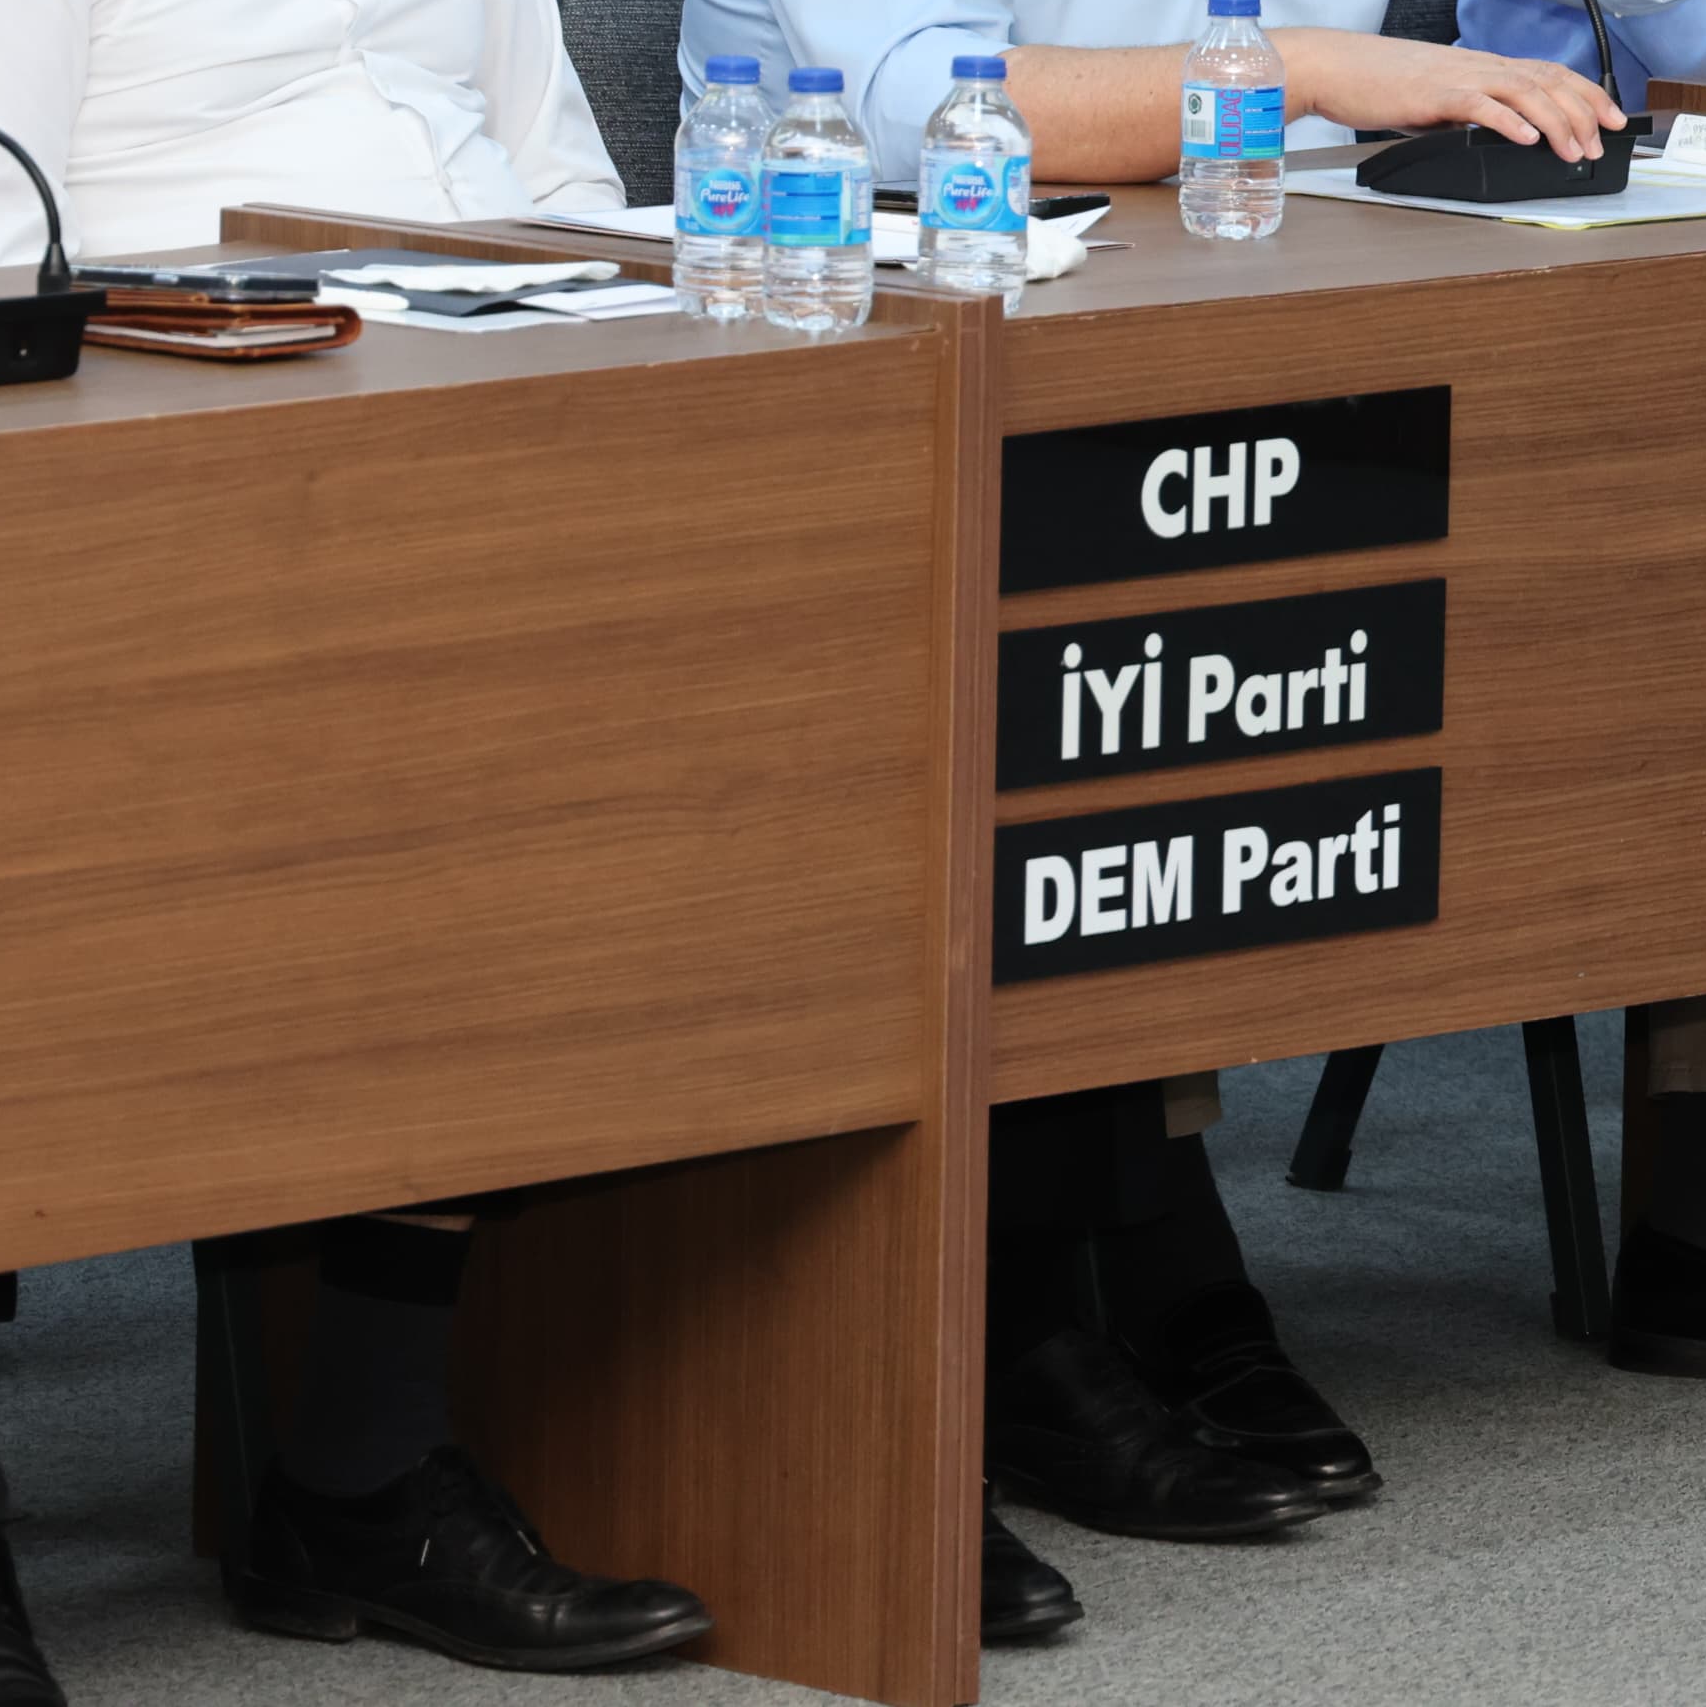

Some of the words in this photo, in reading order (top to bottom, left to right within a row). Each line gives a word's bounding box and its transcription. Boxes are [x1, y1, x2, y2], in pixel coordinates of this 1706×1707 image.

[1141, 438, 1300, 538] CHP
[1061, 632, 1163, 760] İYİ
[1188, 629, 1368, 743] Parti
[1024, 835, 1193, 945] DEM
[1222, 804, 1400, 914] Parti
